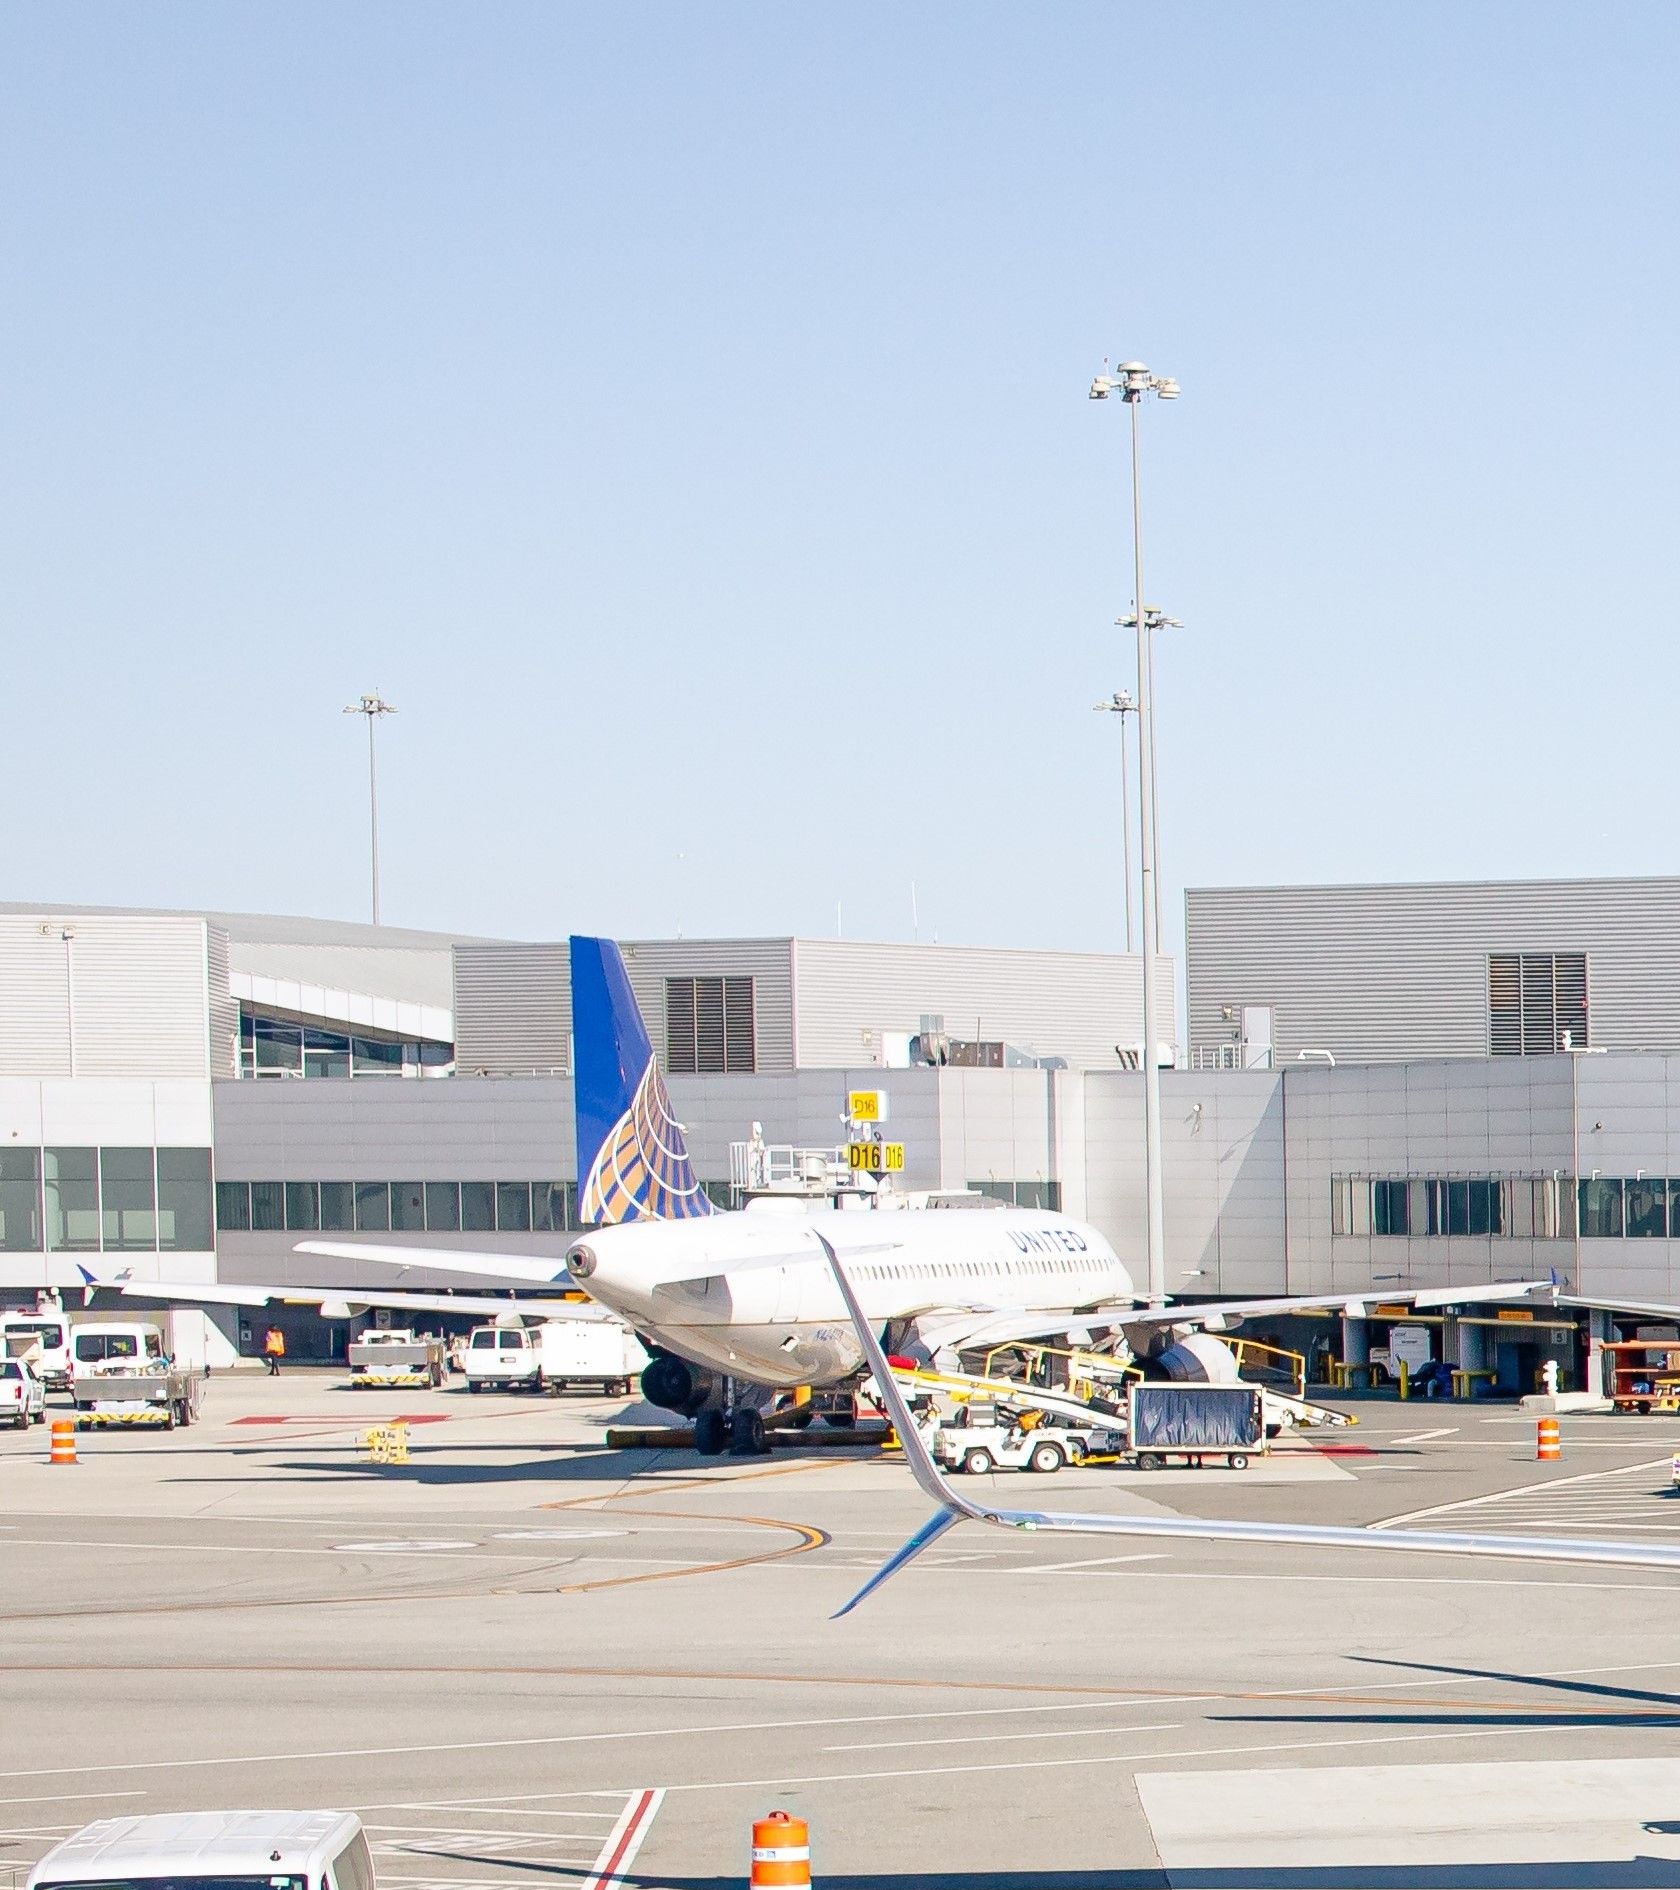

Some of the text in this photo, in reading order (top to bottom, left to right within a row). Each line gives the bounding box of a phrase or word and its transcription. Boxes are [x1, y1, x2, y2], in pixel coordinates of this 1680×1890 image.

[850, 1145, 881, 1168] D16
[885, 1145, 903, 1169] D16
[1005, 1229, 1088, 1253] UNITED
